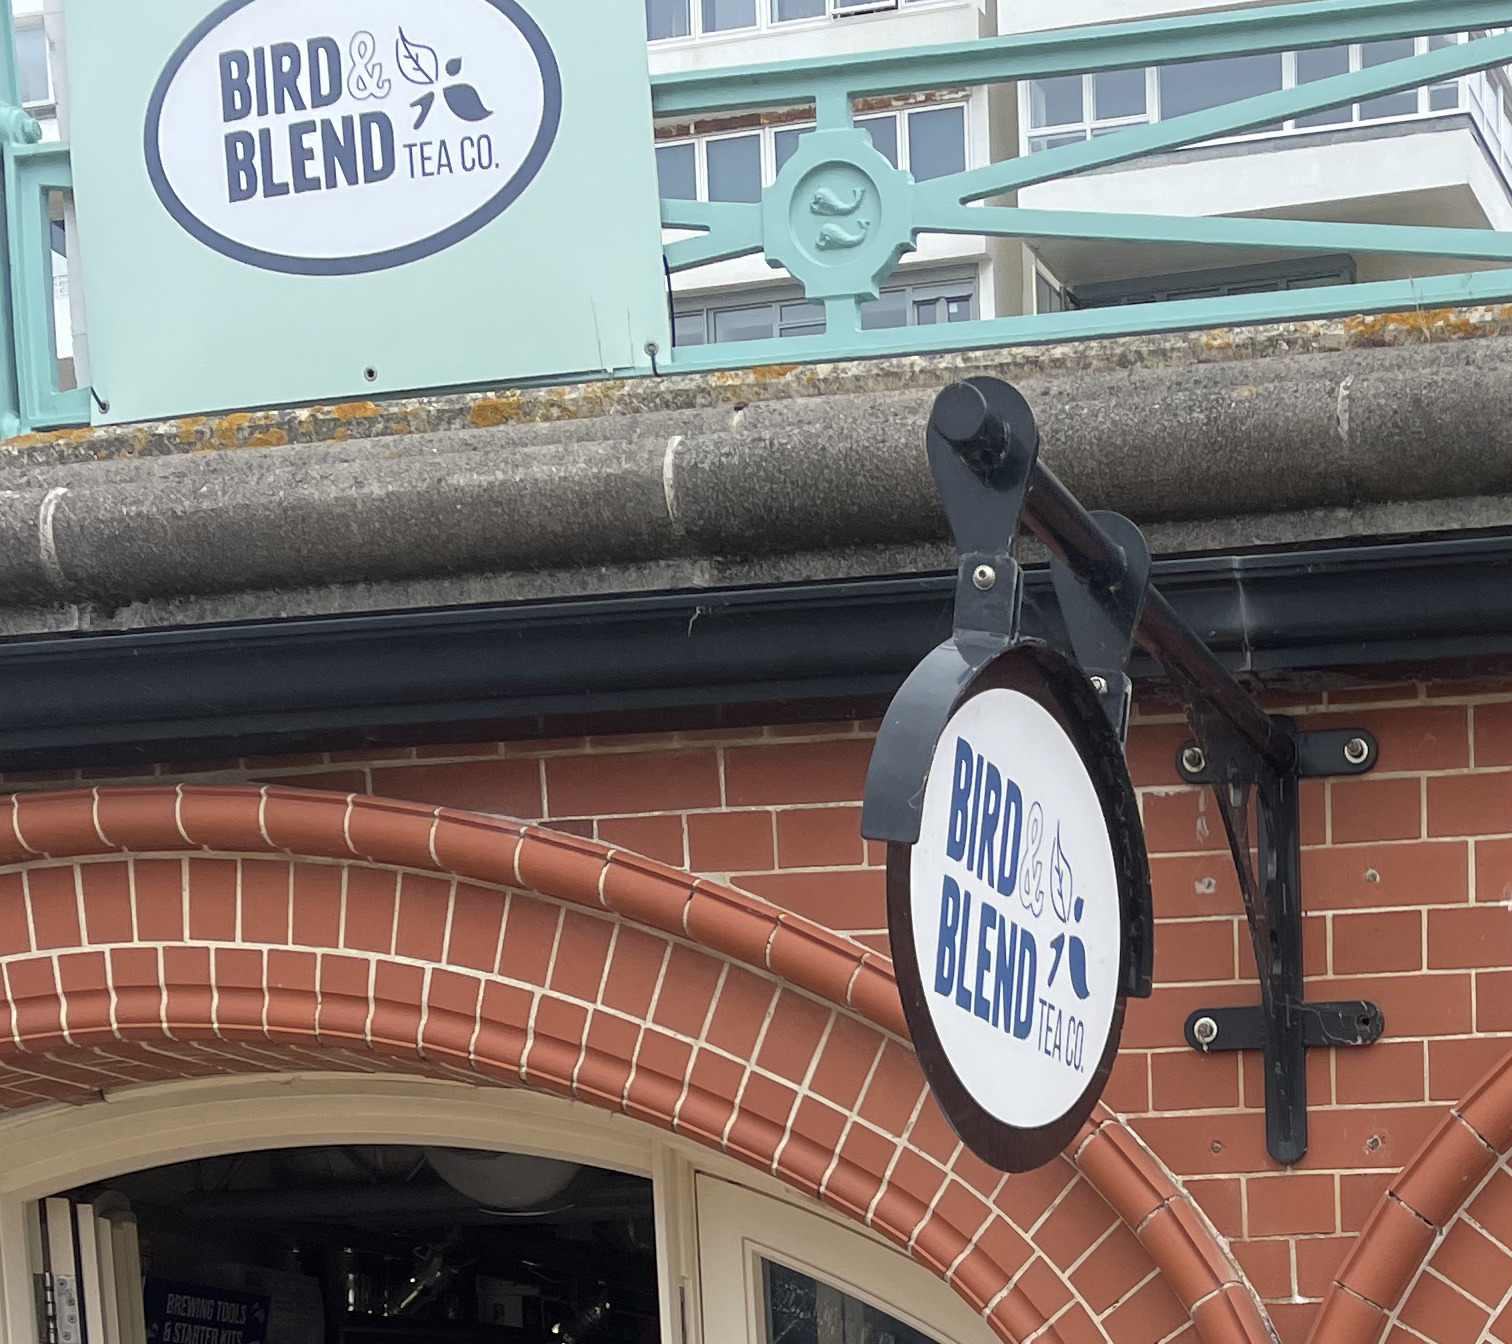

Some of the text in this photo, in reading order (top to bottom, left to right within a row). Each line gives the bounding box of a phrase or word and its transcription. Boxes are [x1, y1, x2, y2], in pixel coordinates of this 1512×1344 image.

[224, 110, 501, 204] BLEND TEA CO.
[934, 873, 1085, 1074] BLEND TEA CO.
[165, 1293, 248, 1325] BREWING TOOLS
